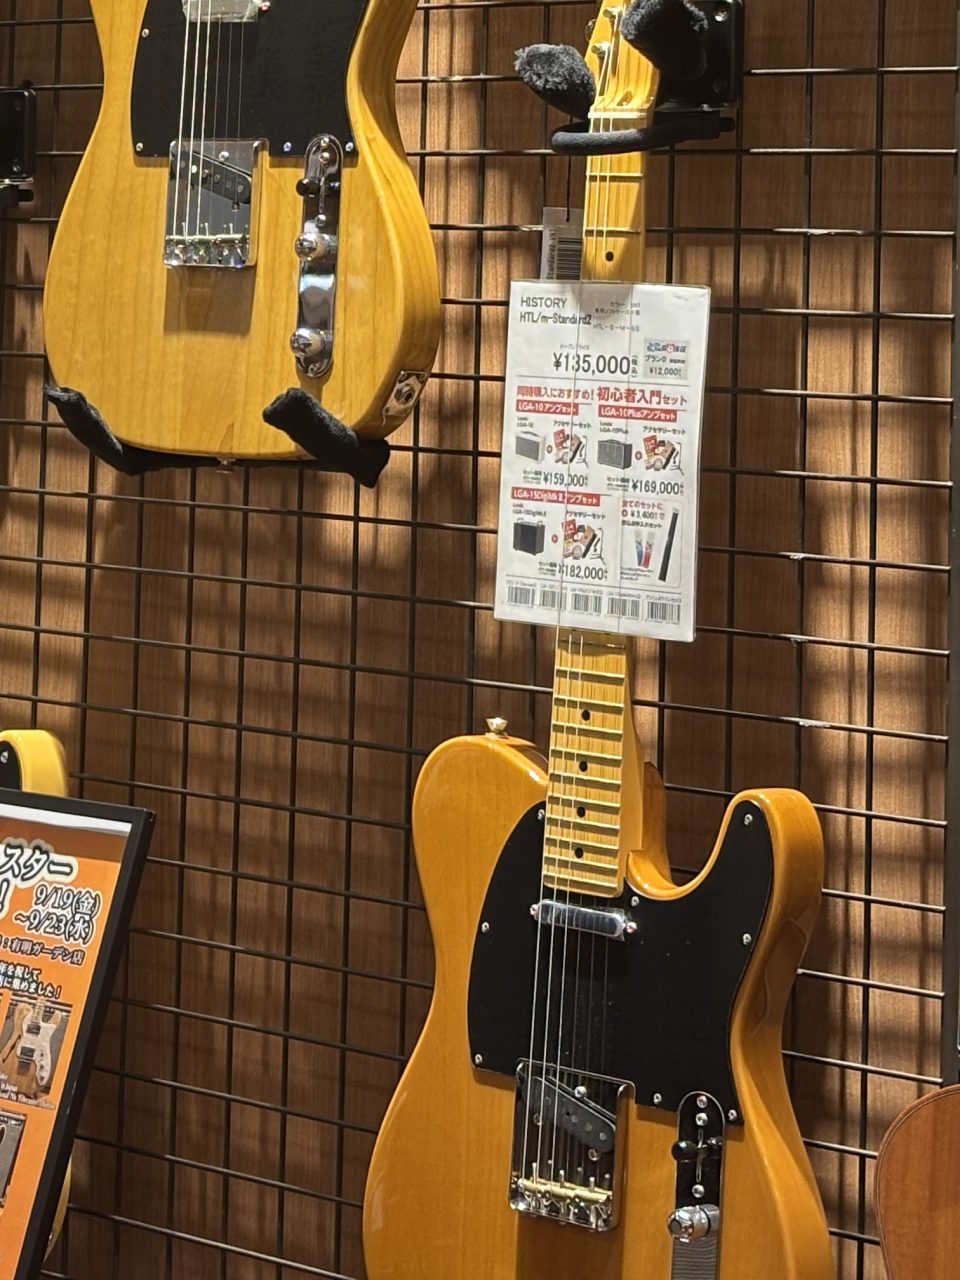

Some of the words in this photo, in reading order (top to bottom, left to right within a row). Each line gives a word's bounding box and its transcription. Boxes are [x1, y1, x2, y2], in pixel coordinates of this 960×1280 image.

[521, 297, 567, 308] HISTORY
[520, 312, 592, 325] HTL/m-Standard2
[553, 353, 630, 375] ¥135,000
[597, 386, 687, 406] 初心者入門セット
[543, 472, 585, 487] ¥159,000
[632, 479, 680, 495] ¥169,000
[559, 564, 604, 580] ¥182,000
[34, 883, 101, 917] 9/19(金)
